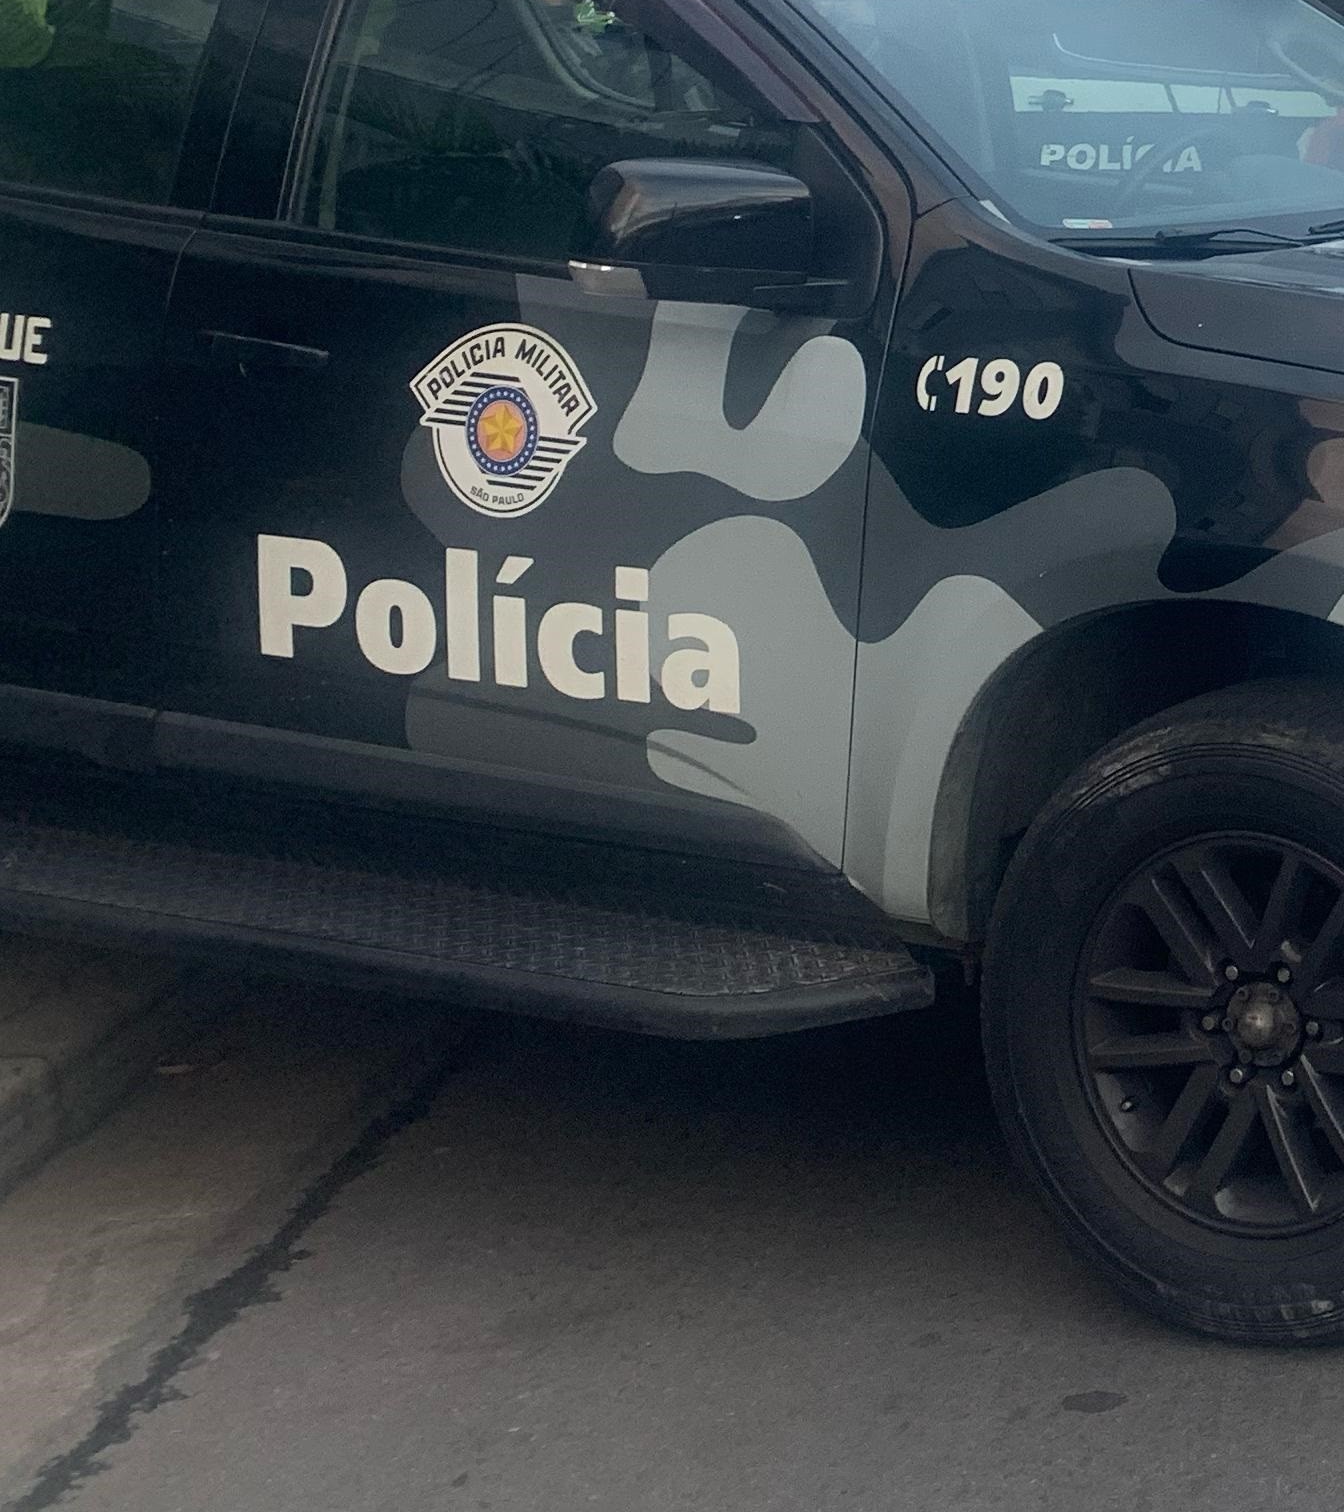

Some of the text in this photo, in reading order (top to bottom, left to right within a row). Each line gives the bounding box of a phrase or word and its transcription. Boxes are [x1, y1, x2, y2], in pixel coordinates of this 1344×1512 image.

[427, 336, 581, 418] POLICIA MILITAR
[946, 356, 1065, 420] 190
[492, 492, 525, 505] PAULO
[256, 533, 742, 715] Polícia
